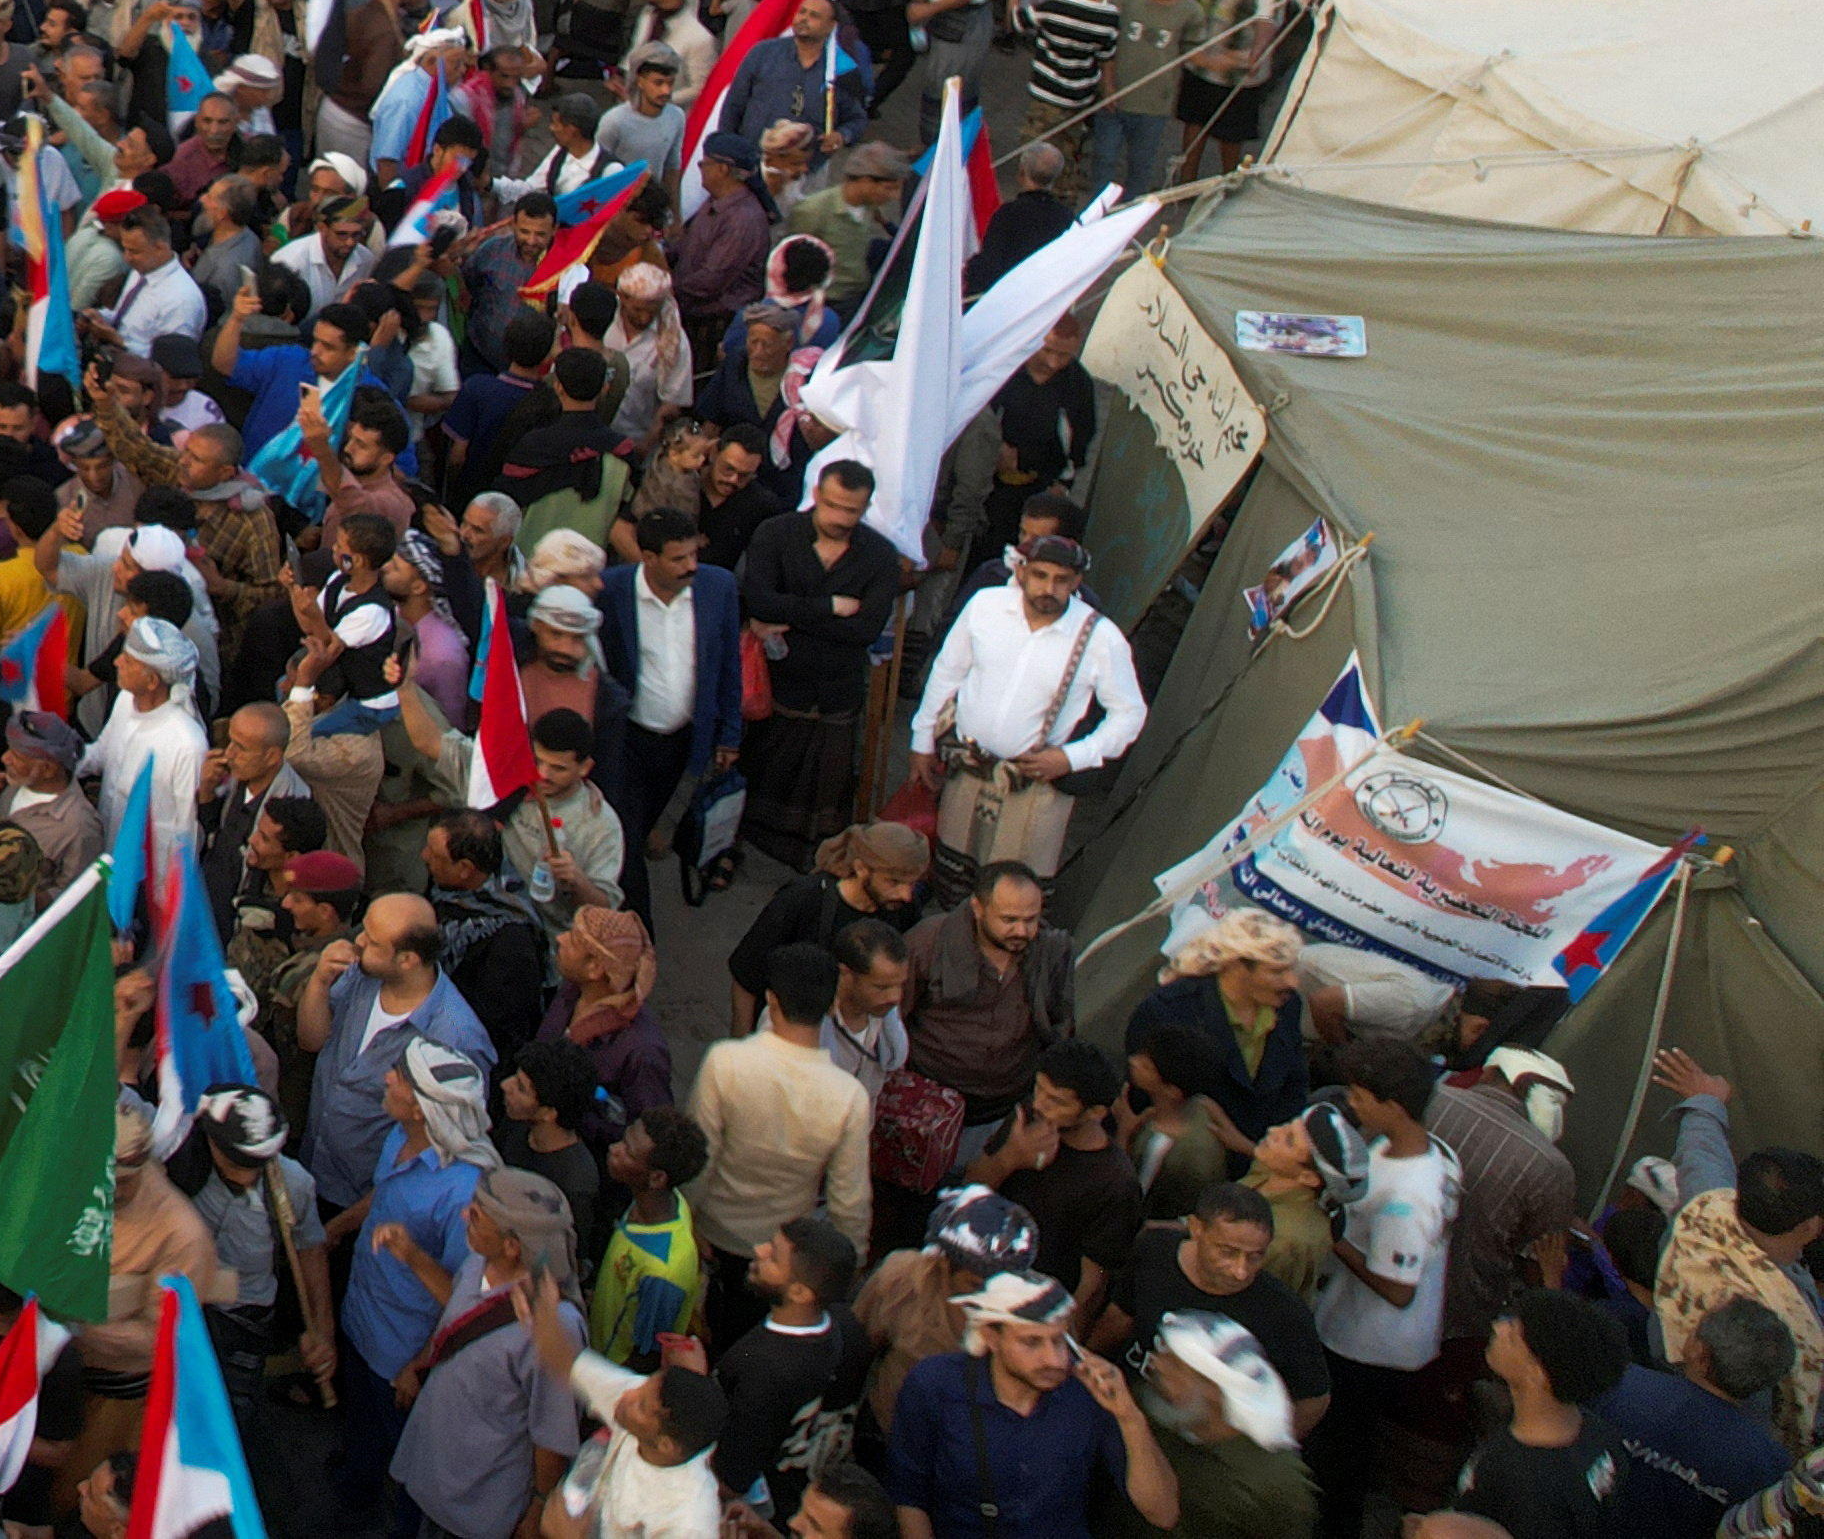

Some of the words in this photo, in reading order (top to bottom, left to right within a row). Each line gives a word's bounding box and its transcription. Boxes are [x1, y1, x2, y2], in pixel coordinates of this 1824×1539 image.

[1137, 294, 1189, 362] السلام
[1318, 828, 1350, 851] يوم
[1352, 837, 1416, 881] لفعالية
[1340, 886, 1385, 915] حضرموت
[1415, 870, 1502, 922] التحضيرية
[1500, 911, 1554, 939] اللجنة
